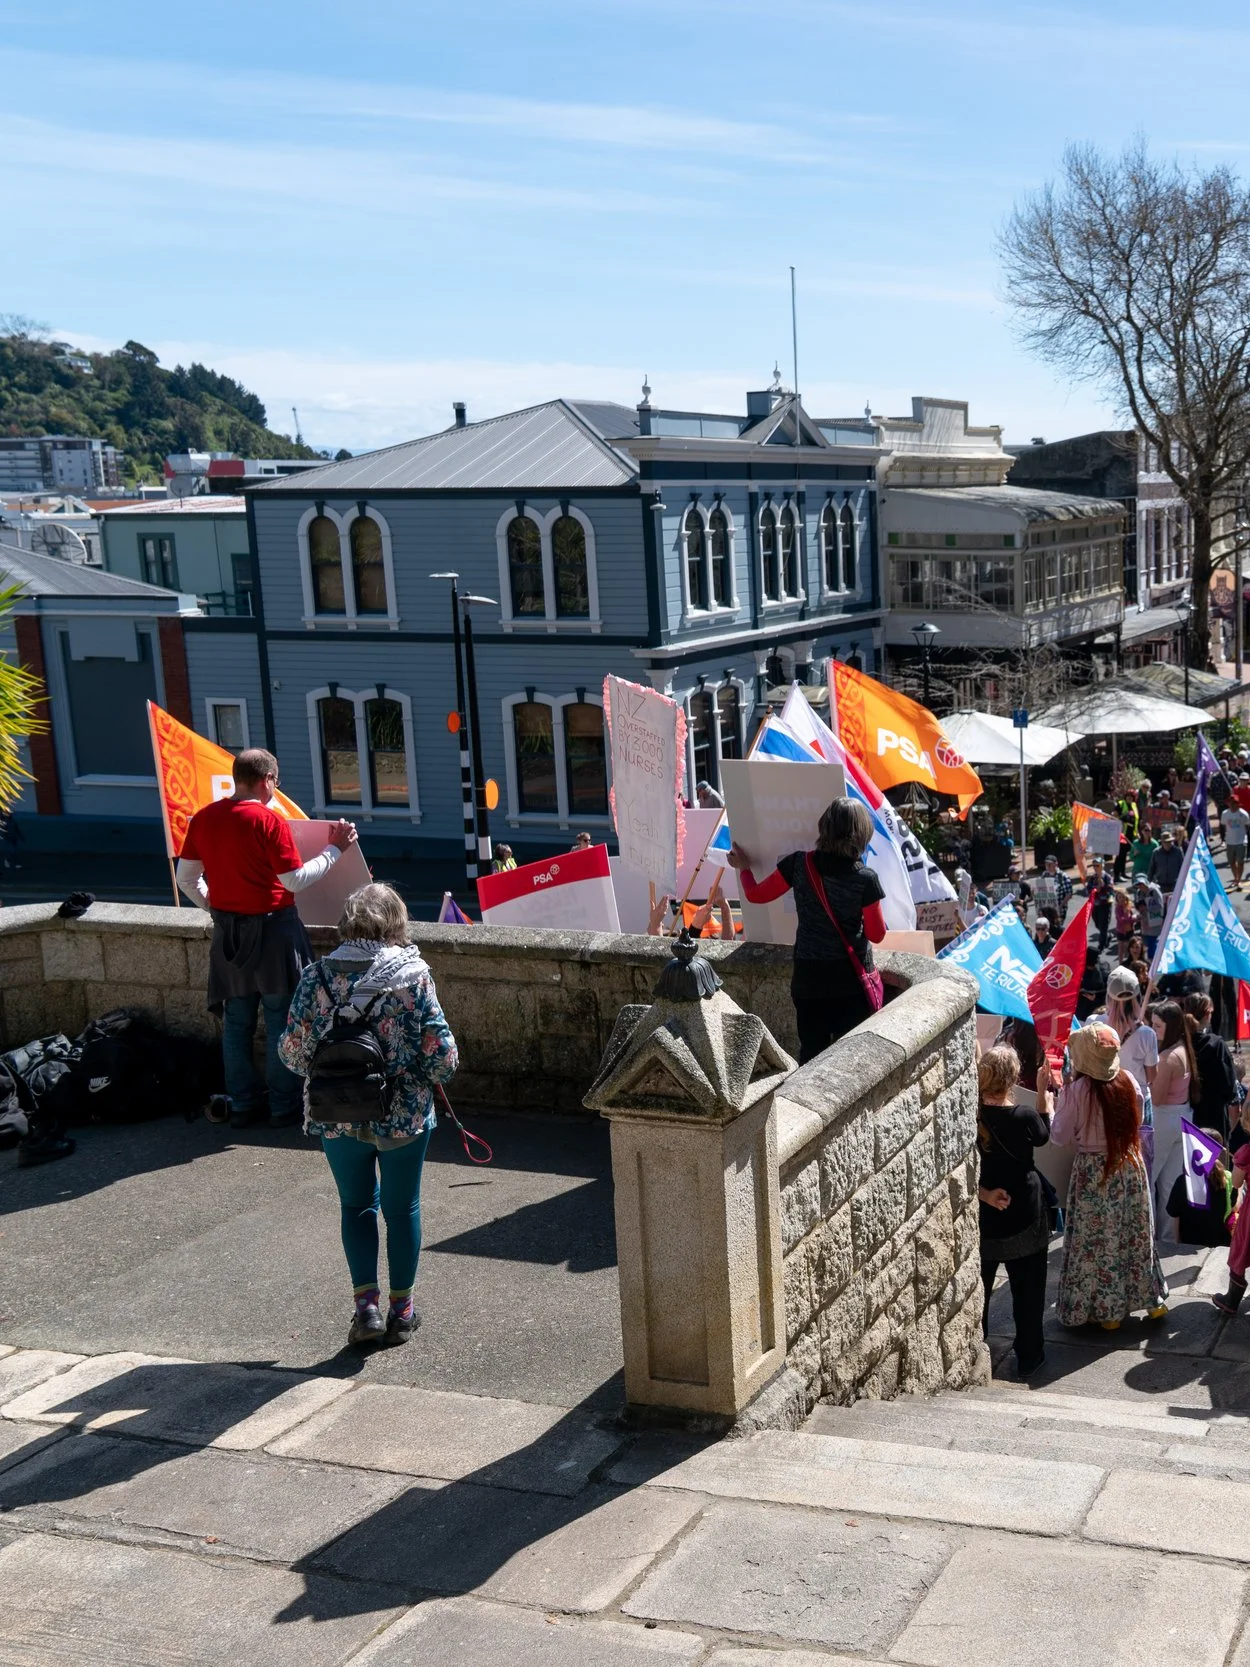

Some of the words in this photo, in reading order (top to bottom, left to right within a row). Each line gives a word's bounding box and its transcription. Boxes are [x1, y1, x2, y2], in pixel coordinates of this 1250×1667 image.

[617, 686, 648, 724] NZ
[617, 715, 666, 746] OVERSTAFFED
[618, 729, 632, 745] BY
[619, 746, 664, 780] NURSES
[877, 727, 937, 780] PSA
[532, 871, 553, 886] PSA
[90, 1076, 109, 1088] NIKE
